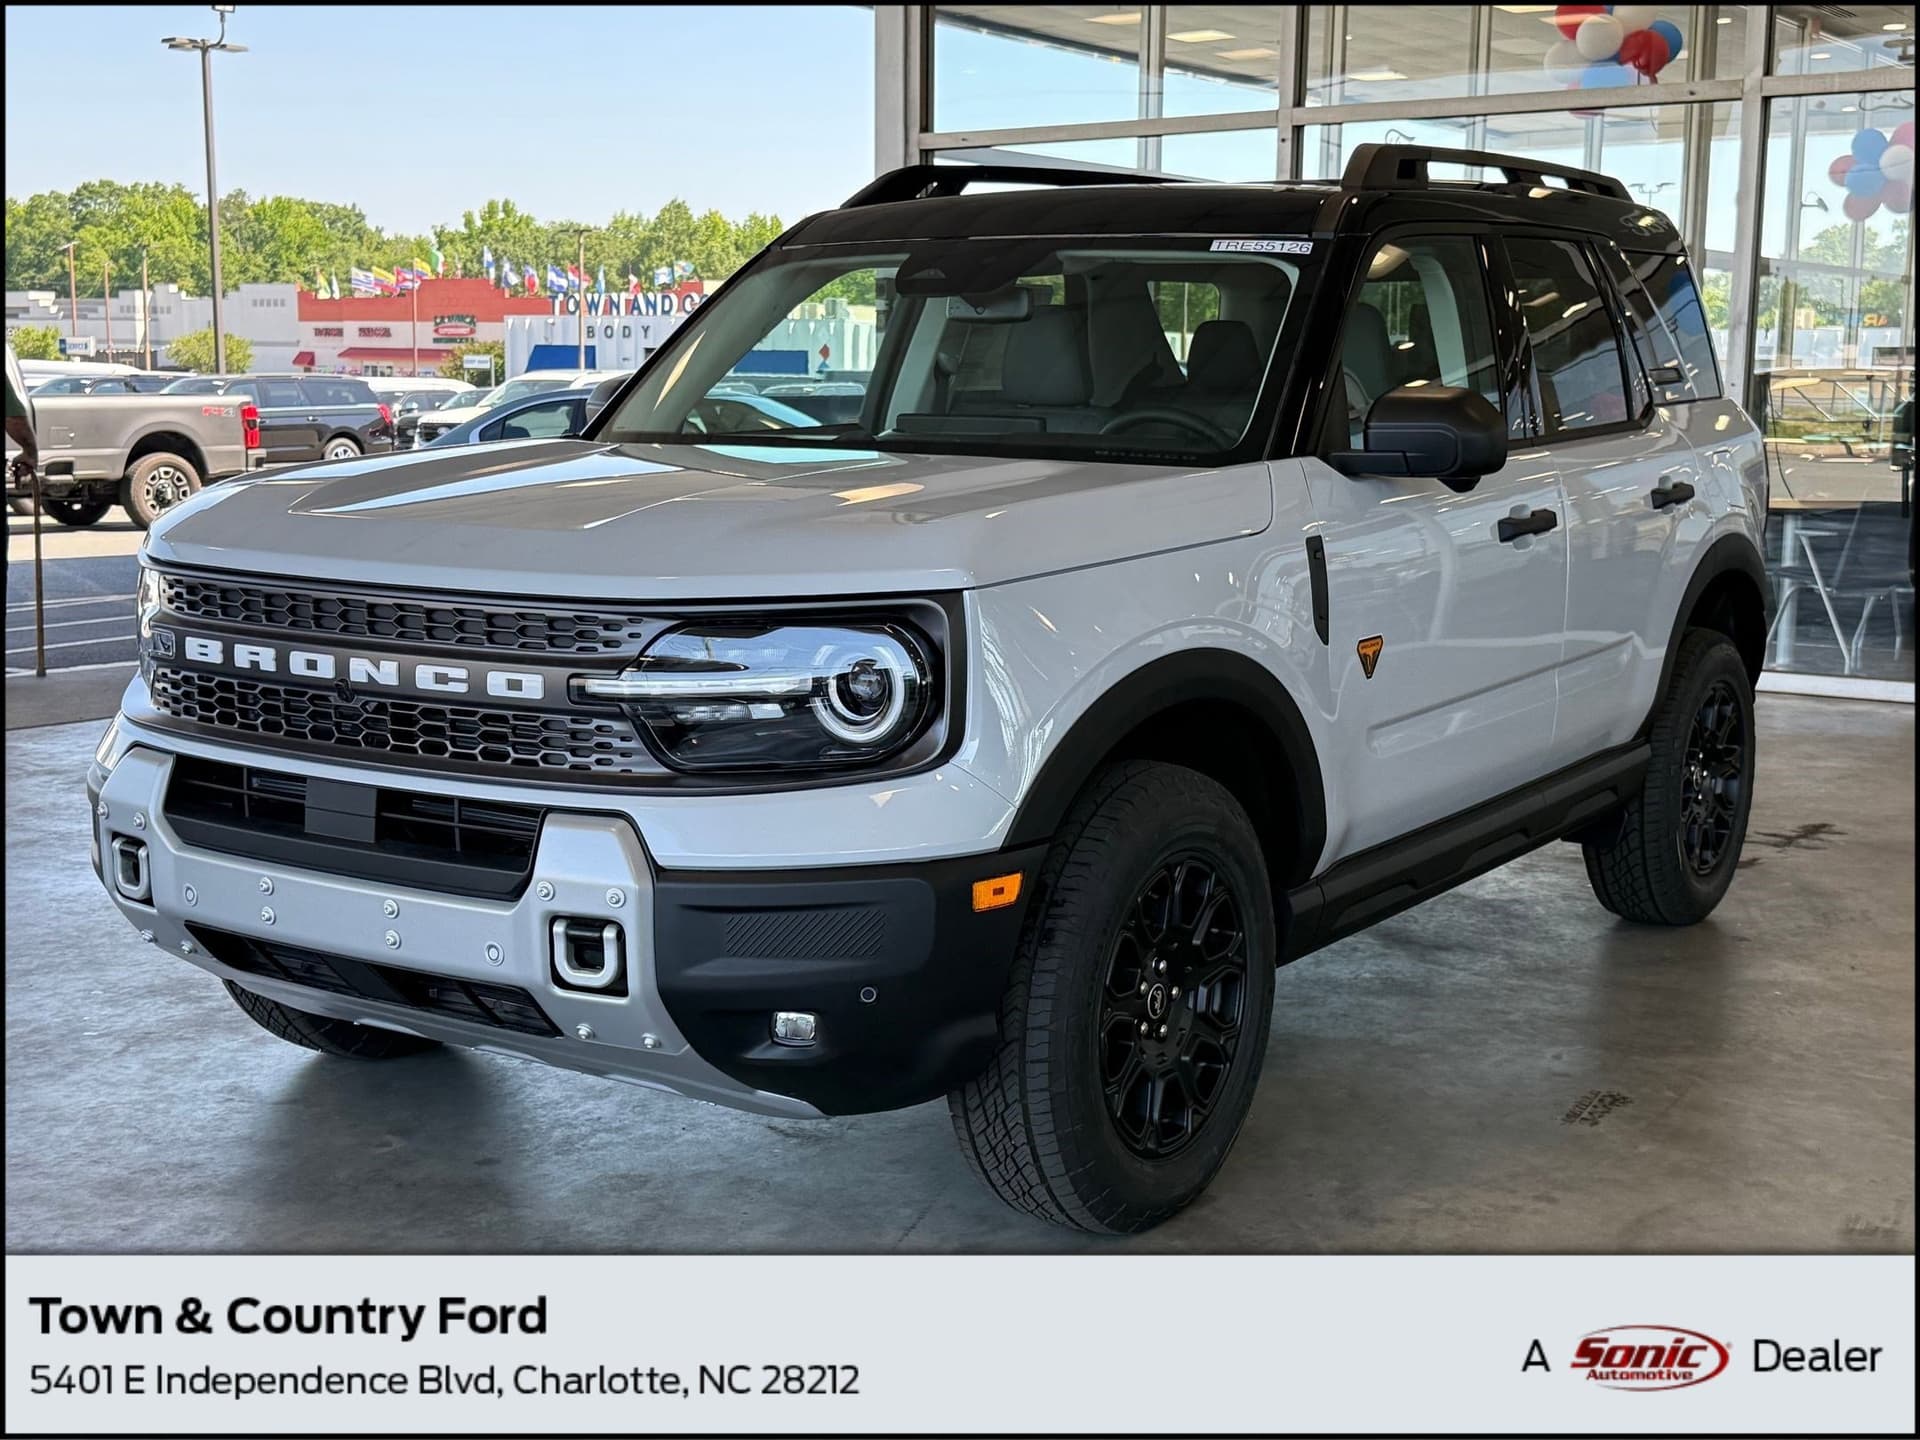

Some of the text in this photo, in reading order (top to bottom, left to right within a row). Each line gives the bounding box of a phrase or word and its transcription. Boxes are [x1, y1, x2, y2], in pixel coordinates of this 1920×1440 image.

[1214, 240, 1311, 254] TRE55126
[549, 292, 622, 317] TOWN
[630, 292, 676, 317] AND
[585, 325, 651, 340] BODY
[184, 636, 545, 701] BRONCO
